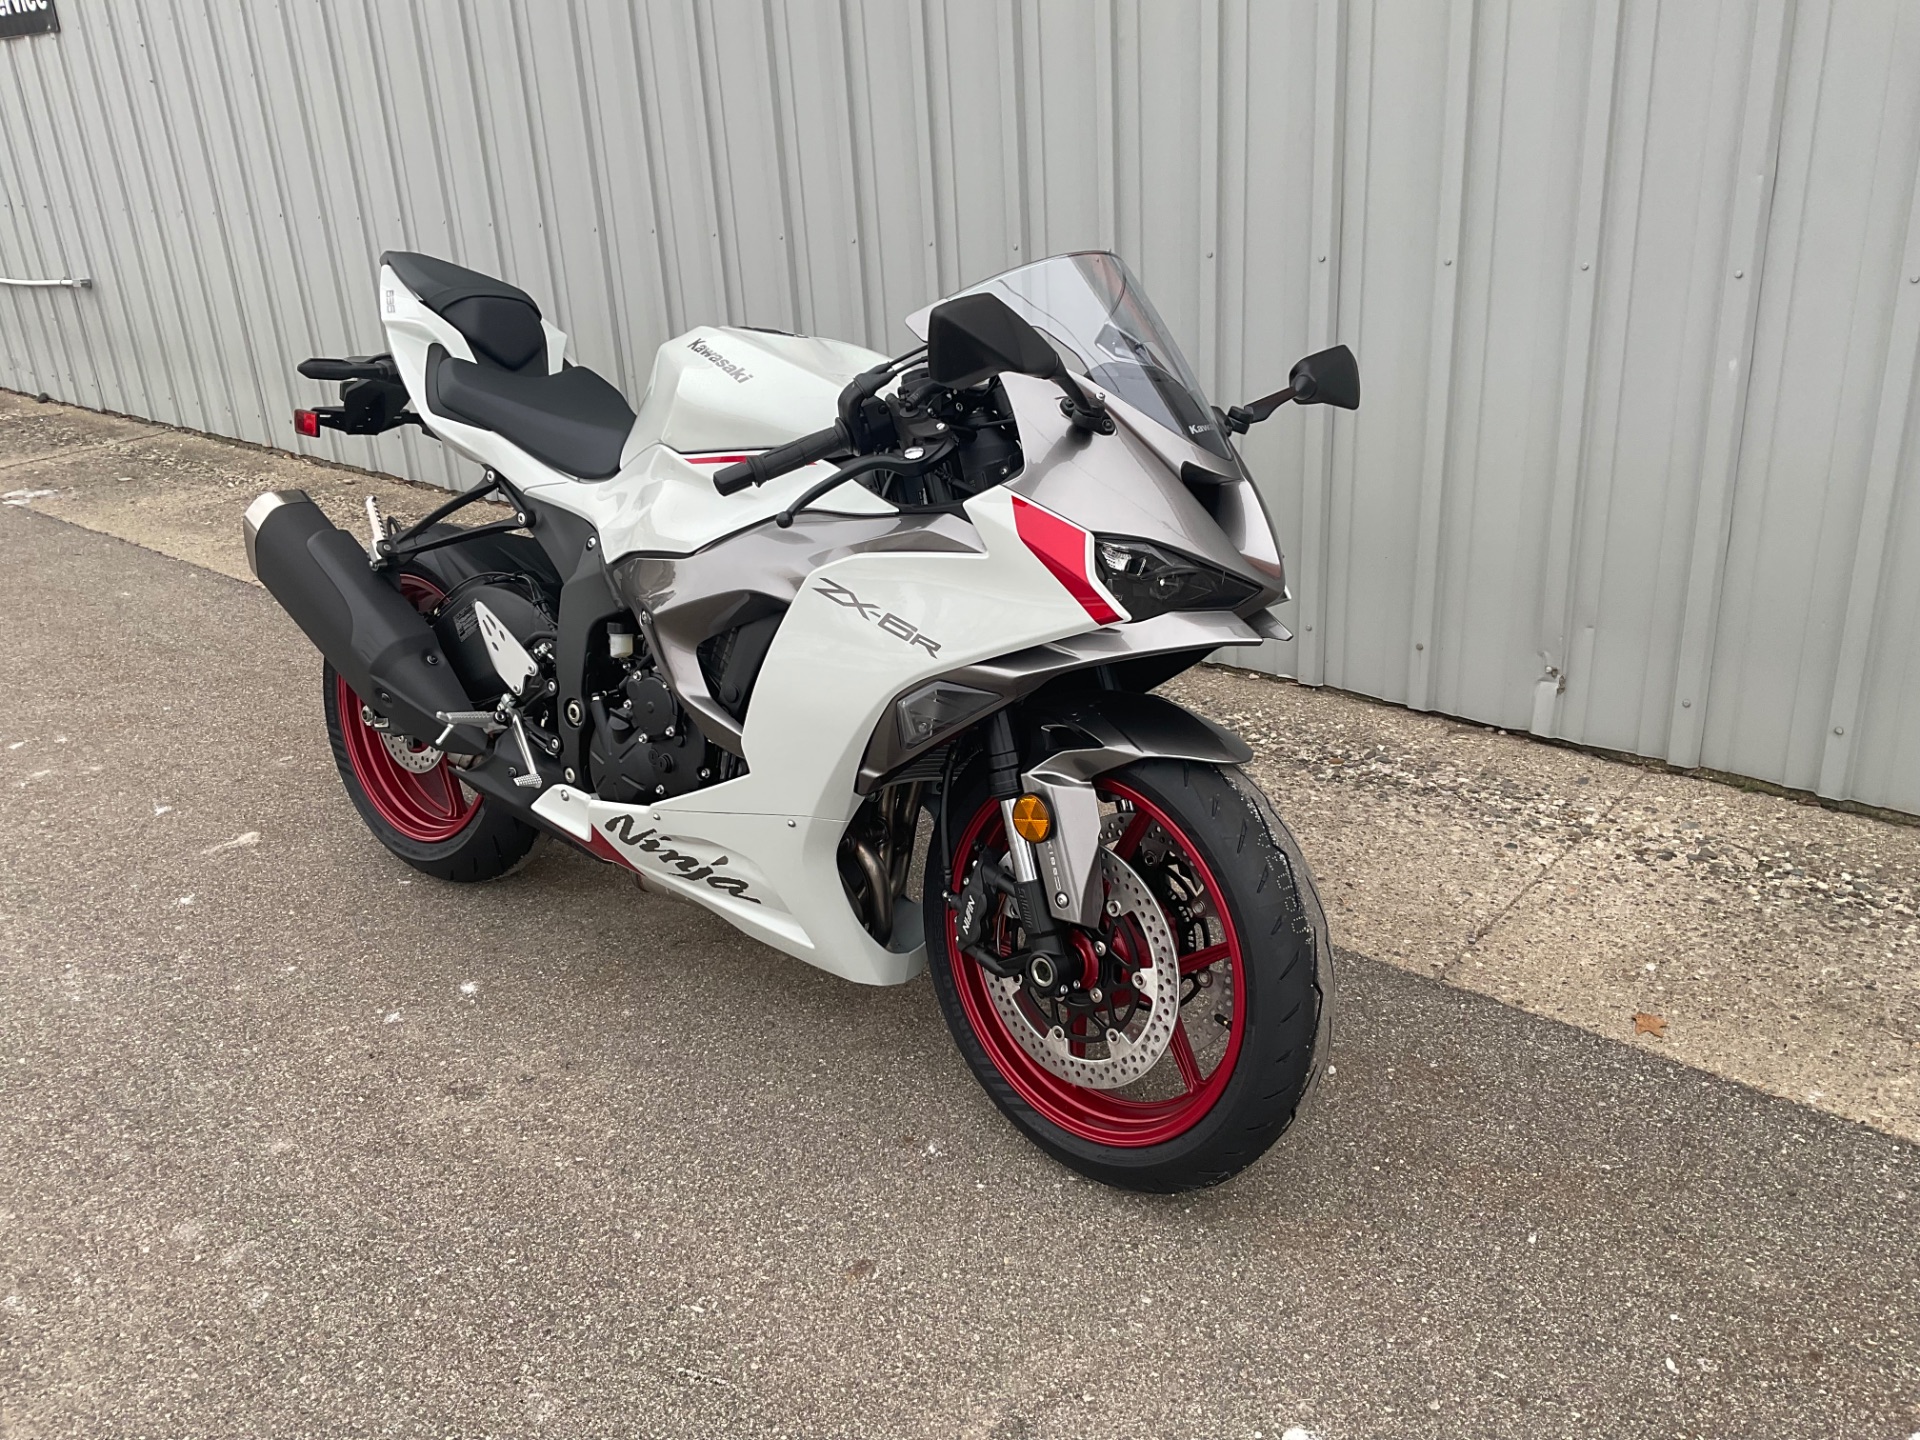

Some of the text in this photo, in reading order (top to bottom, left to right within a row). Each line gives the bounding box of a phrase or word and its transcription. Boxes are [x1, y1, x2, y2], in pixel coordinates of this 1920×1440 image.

[686, 337, 754, 384] Kawasaki
[811, 577, 942, 660] ZX-6R
[604, 814, 762, 905] Ninja
